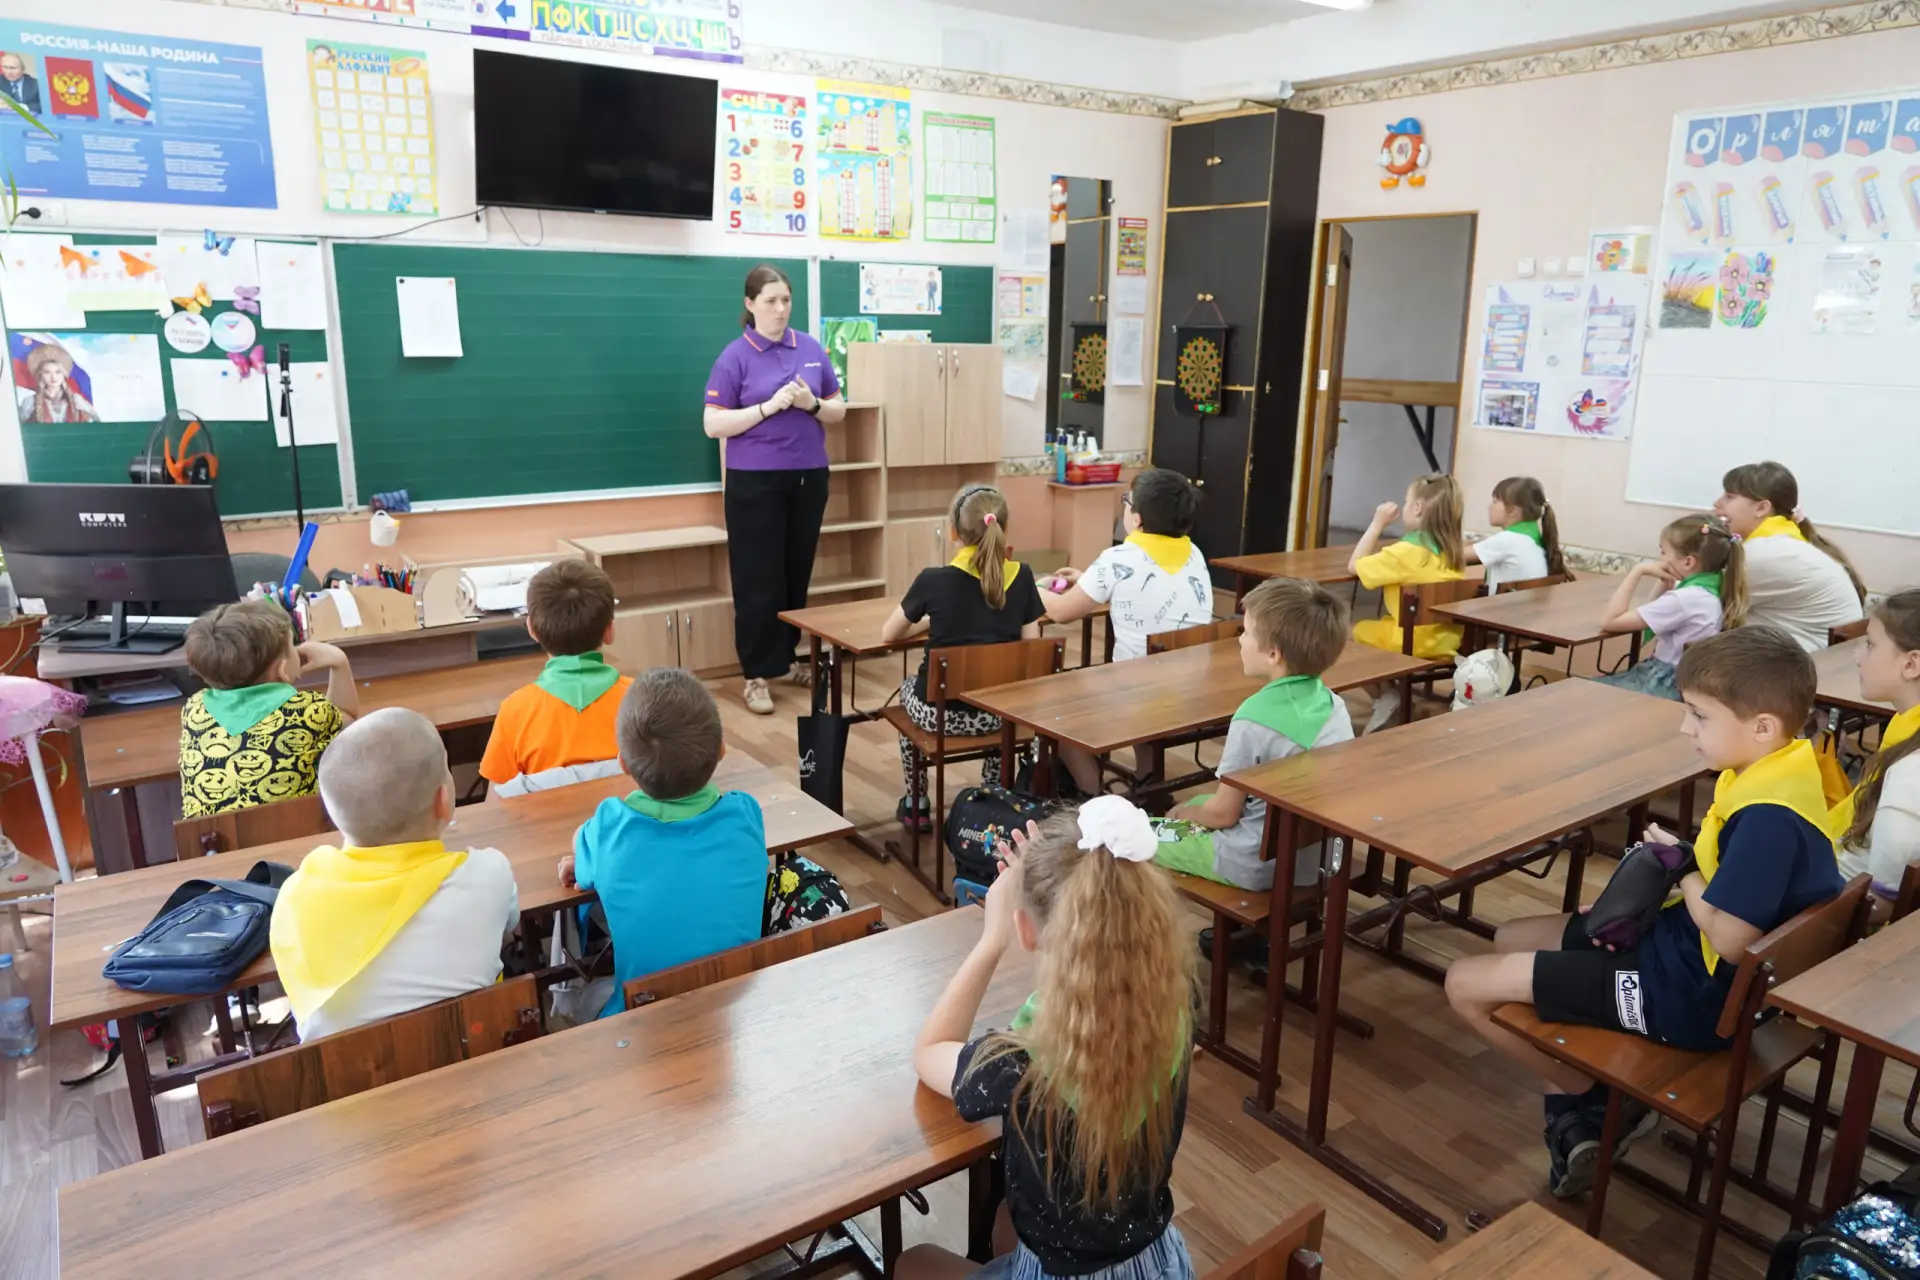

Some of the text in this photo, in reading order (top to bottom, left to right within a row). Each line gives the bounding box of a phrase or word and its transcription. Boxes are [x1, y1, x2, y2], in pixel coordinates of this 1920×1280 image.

[151, 46, 220, 65] РОДИНА
[337, 61, 392, 75] АЛФАВИТ
[727, 114, 737, 132] 1
[790, 120, 804, 138] 6
[728, 138, 742, 157] 2
[791, 144, 804, 162] 7
[729, 163, 742, 181] 3
[793, 168, 805, 186] 8
[729, 187, 743, 205] 4
[793, 191, 806, 209] 9
[729, 210, 742, 228] 5
[785, 214, 806, 232] 10
